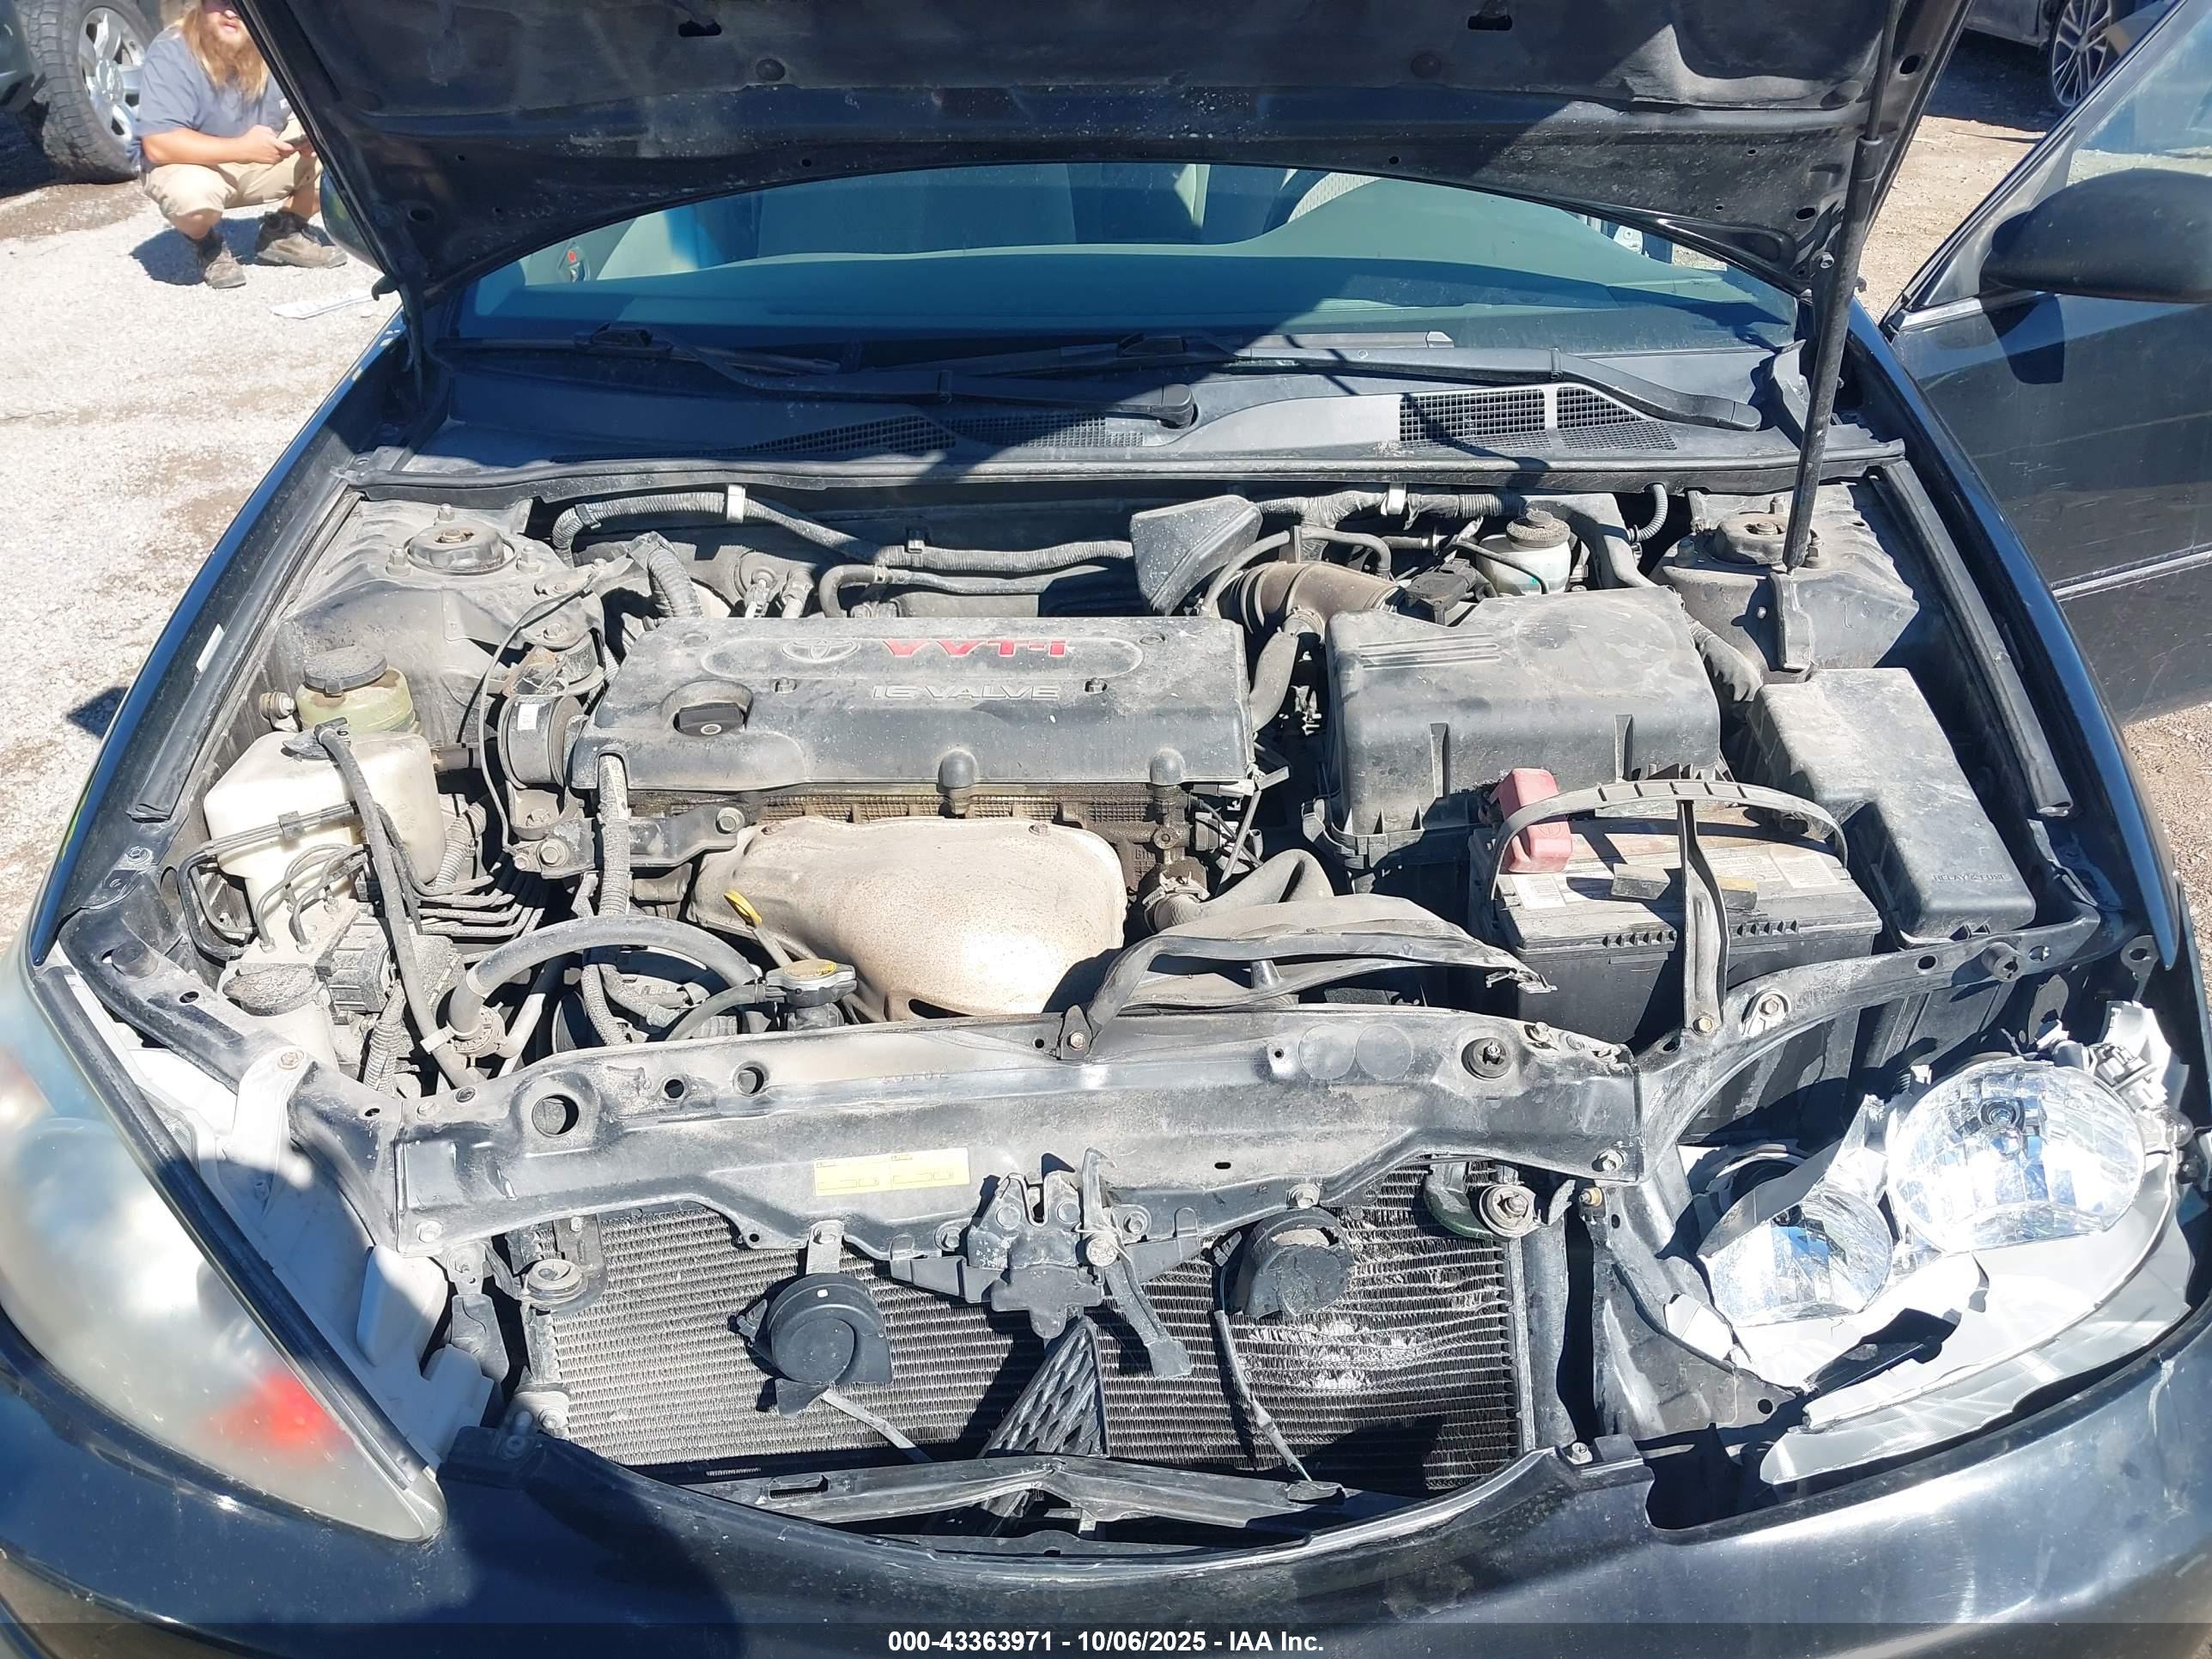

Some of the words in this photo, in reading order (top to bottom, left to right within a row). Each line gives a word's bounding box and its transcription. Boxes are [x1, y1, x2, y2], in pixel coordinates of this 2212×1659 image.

[872, 684, 917, 700] 16
[925, 684, 1063, 700] VALVE
[1932, 873, 1967, 883] RELAY
